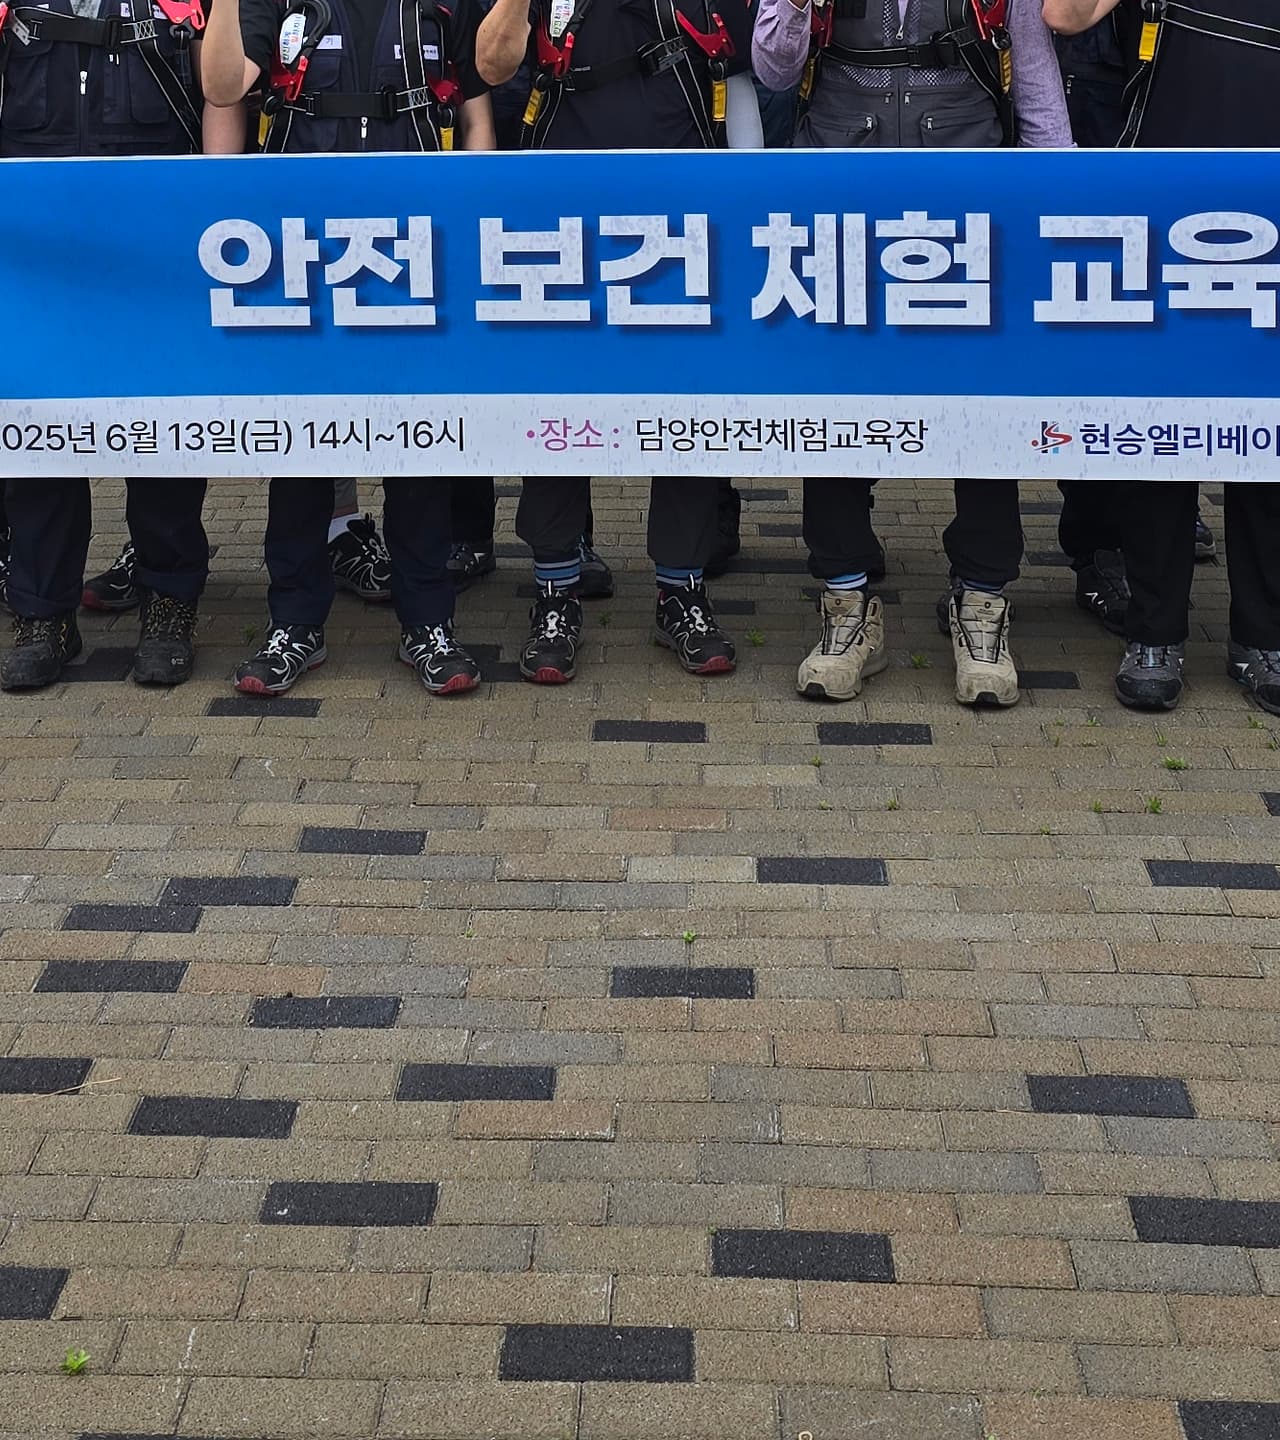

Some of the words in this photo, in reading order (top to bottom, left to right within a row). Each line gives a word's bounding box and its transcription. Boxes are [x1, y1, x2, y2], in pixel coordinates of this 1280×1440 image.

[198, 215, 438, 328] 안전
[475, 214, 712, 326] 보건
[751, 212, 992, 327] 체험
[106, 420, 160, 455] 6월
[169, 419, 294, 456] 13일(금)
[303, 418, 466, 453] 14시~16시
[635, 417, 930, 454] 담양안전체험교육장
